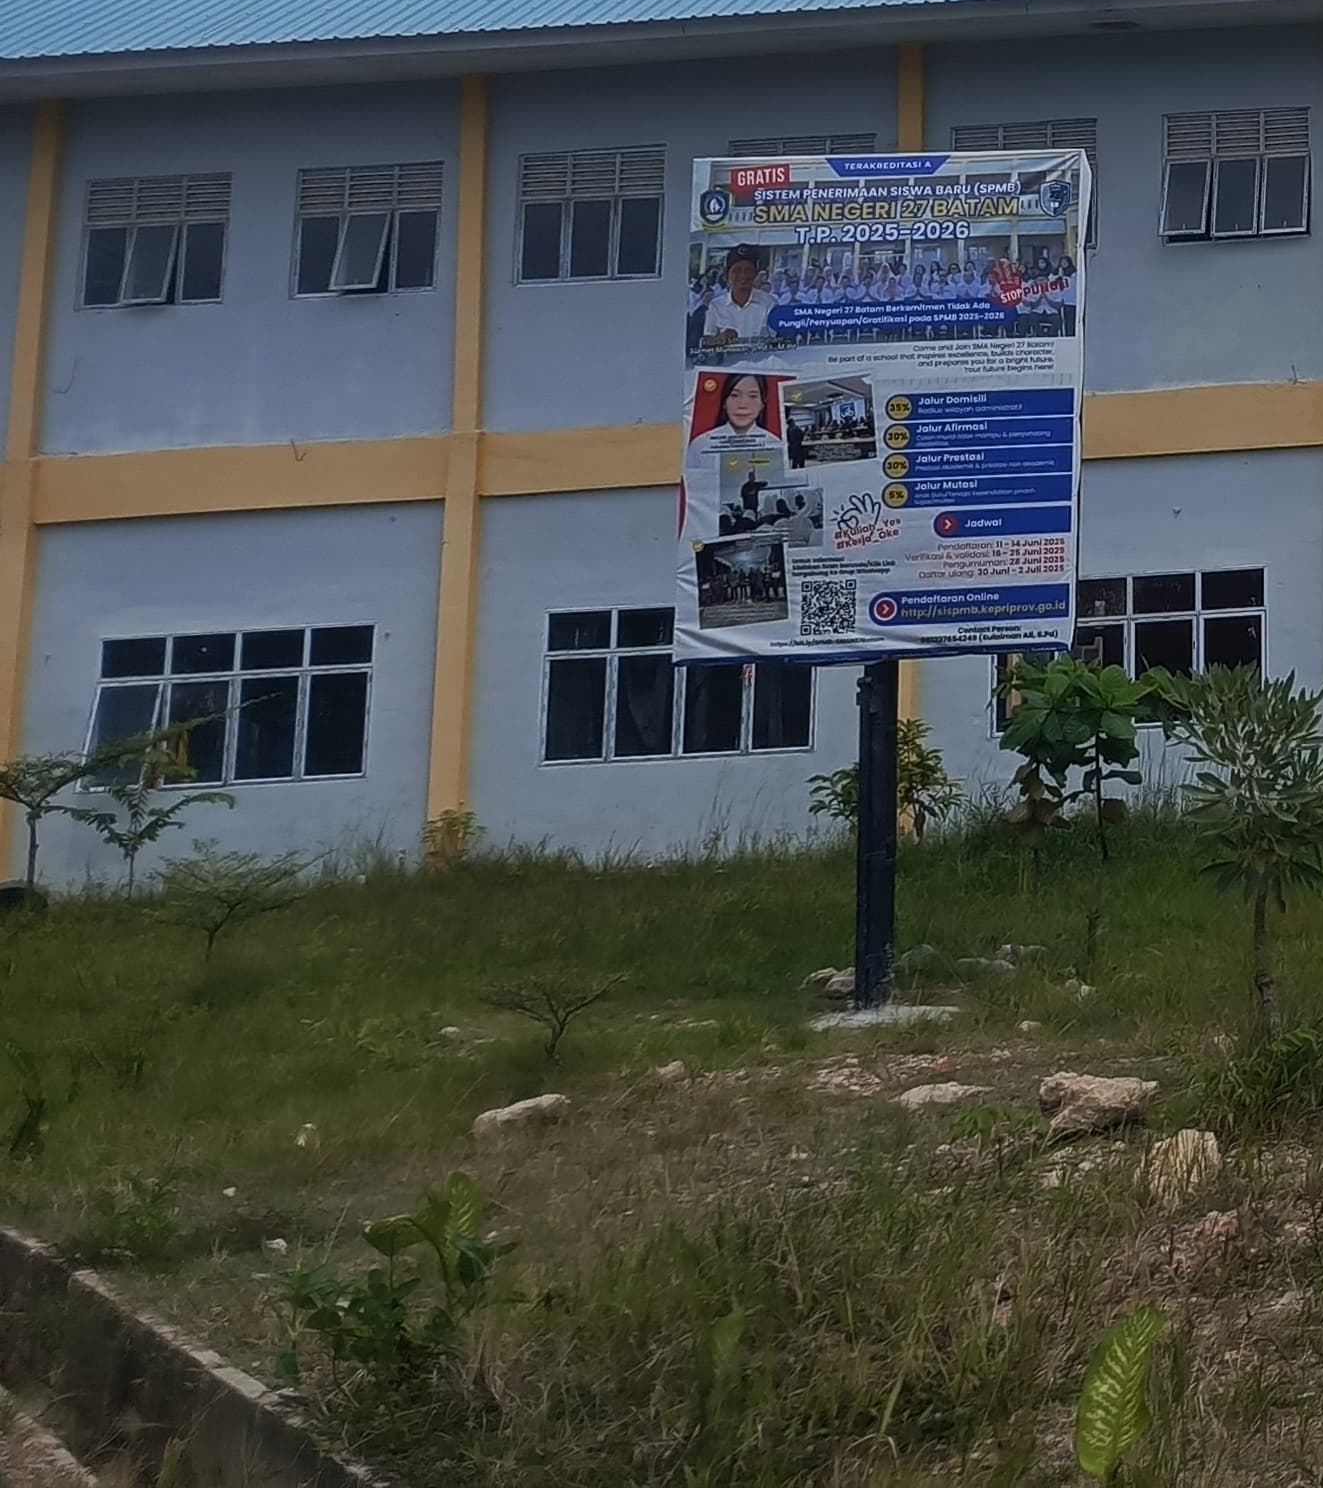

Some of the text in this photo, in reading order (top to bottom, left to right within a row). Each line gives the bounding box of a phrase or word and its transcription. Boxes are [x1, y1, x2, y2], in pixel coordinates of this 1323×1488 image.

[844, 161, 922, 171] TERAKREDITASI
[737, 167, 785, 187] GRATIS
[754, 181, 1022, 201] SISTEM PENERIMAAN SISWA BARU (SPMB)
[754, 197, 1019, 223] SMA NEGERI 27 BATAM
[796, 221, 970, 244] T.P. 2025-2026
[794, 308, 813, 316] SMA
[815, 307, 843, 316] Negeri
[856, 306, 884, 314] Batam
[886, 304, 945, 312] Berkomitmen
[909, 315, 932, 324] pada
[839, 355, 855, 364] part
[918, 359, 933, 367] and
[1006, 357, 1029, 365] bright
[1007, 365, 1032, 373] begins
[918, 397, 944, 406] Jalur
[946, 394, 987, 404] Domisili
[916, 424, 942, 433] Jalur
[945, 422, 988, 432] Afirmasi
[915, 455, 942, 464] Jalur
[944, 452, 985, 462] Prestasi
[914, 482, 941, 491] Jalur
[943, 480, 978, 489] Mutasi
[965, 519, 1002, 528] Jadwal
[1022, 539, 1042, 547] Juni
[904, 552, 944, 561] Verifikasi
[1021, 548, 1042, 556] Juni
[1043, 547, 1065, 555] 2025
[1021, 557, 1041, 565] Juni
[1043, 556, 1065, 564] 2025
[989, 567, 1010, 575] Juni
[901, 592, 1000, 604] Pendaftaran Online
